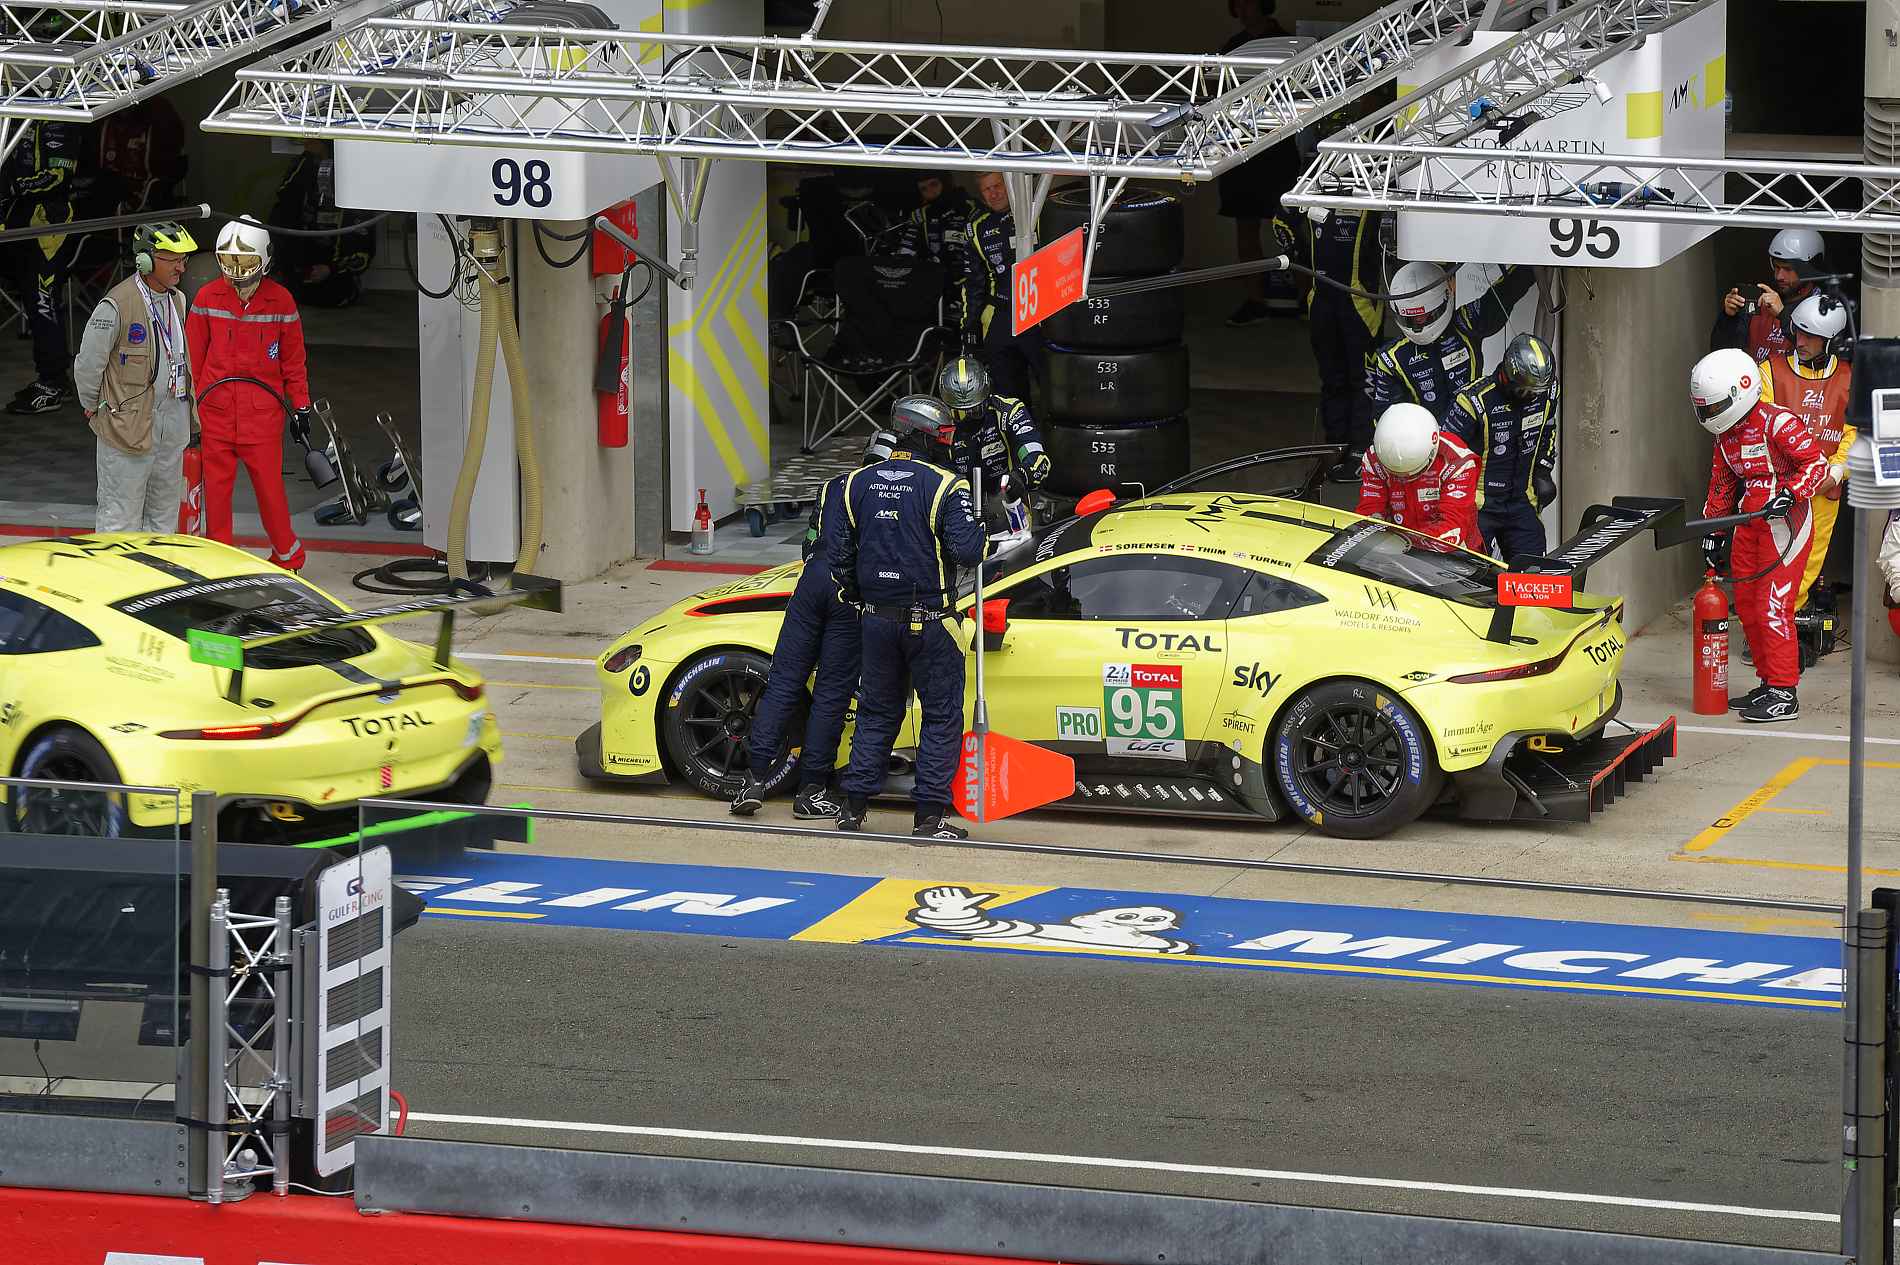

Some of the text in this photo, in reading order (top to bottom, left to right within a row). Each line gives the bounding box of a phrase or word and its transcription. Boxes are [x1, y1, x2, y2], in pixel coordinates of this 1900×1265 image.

[491, 157, 553, 208] 98
[1550, 218, 1621, 260] 95
[1018, 266, 1039, 321] 95
[1088, 298, 1110, 309] 533
[1093, 315, 1109, 325] RF
[1097, 361, 1118, 374] 533
[1100, 381, 1116, 391] LR
[1819, 415, 1831, 426] TV
[1091, 441, 1117, 454] 533
[1100, 463, 1117, 476] RR
[1250, 554, 1292, 569] TURNER
[1505, 580, 1565, 595] HACKETT
[1519, 593, 1550, 601] LONDON
[1334, 608, 1422, 628] WALDORF ASTORIA
[1115, 627, 1222, 652] TOTAL
[1582, 635, 1624, 666] TOTAL
[678, 657, 721, 690] MICHELIN
[1133, 670, 1180, 683] TOTAL
[1232, 662, 1282, 697] sky
[1407, 673, 1430, 681] DOW
[1111, 688, 1176, 739] 95
[342, 710, 434, 738] TOTAL
[1059, 712, 1099, 736] PRO
[1223, 718, 1256, 734] SPIRENT
[1394, 712, 1421, 780] MICHELIN
[1460, 744, 1488, 754] MICHELIN
[617, 757, 651, 765] MICHELIN
[964, 735, 979, 817] START
[1279, 742, 1305, 808] MICHELIN
[328, 888, 384, 922] GULF RCING
